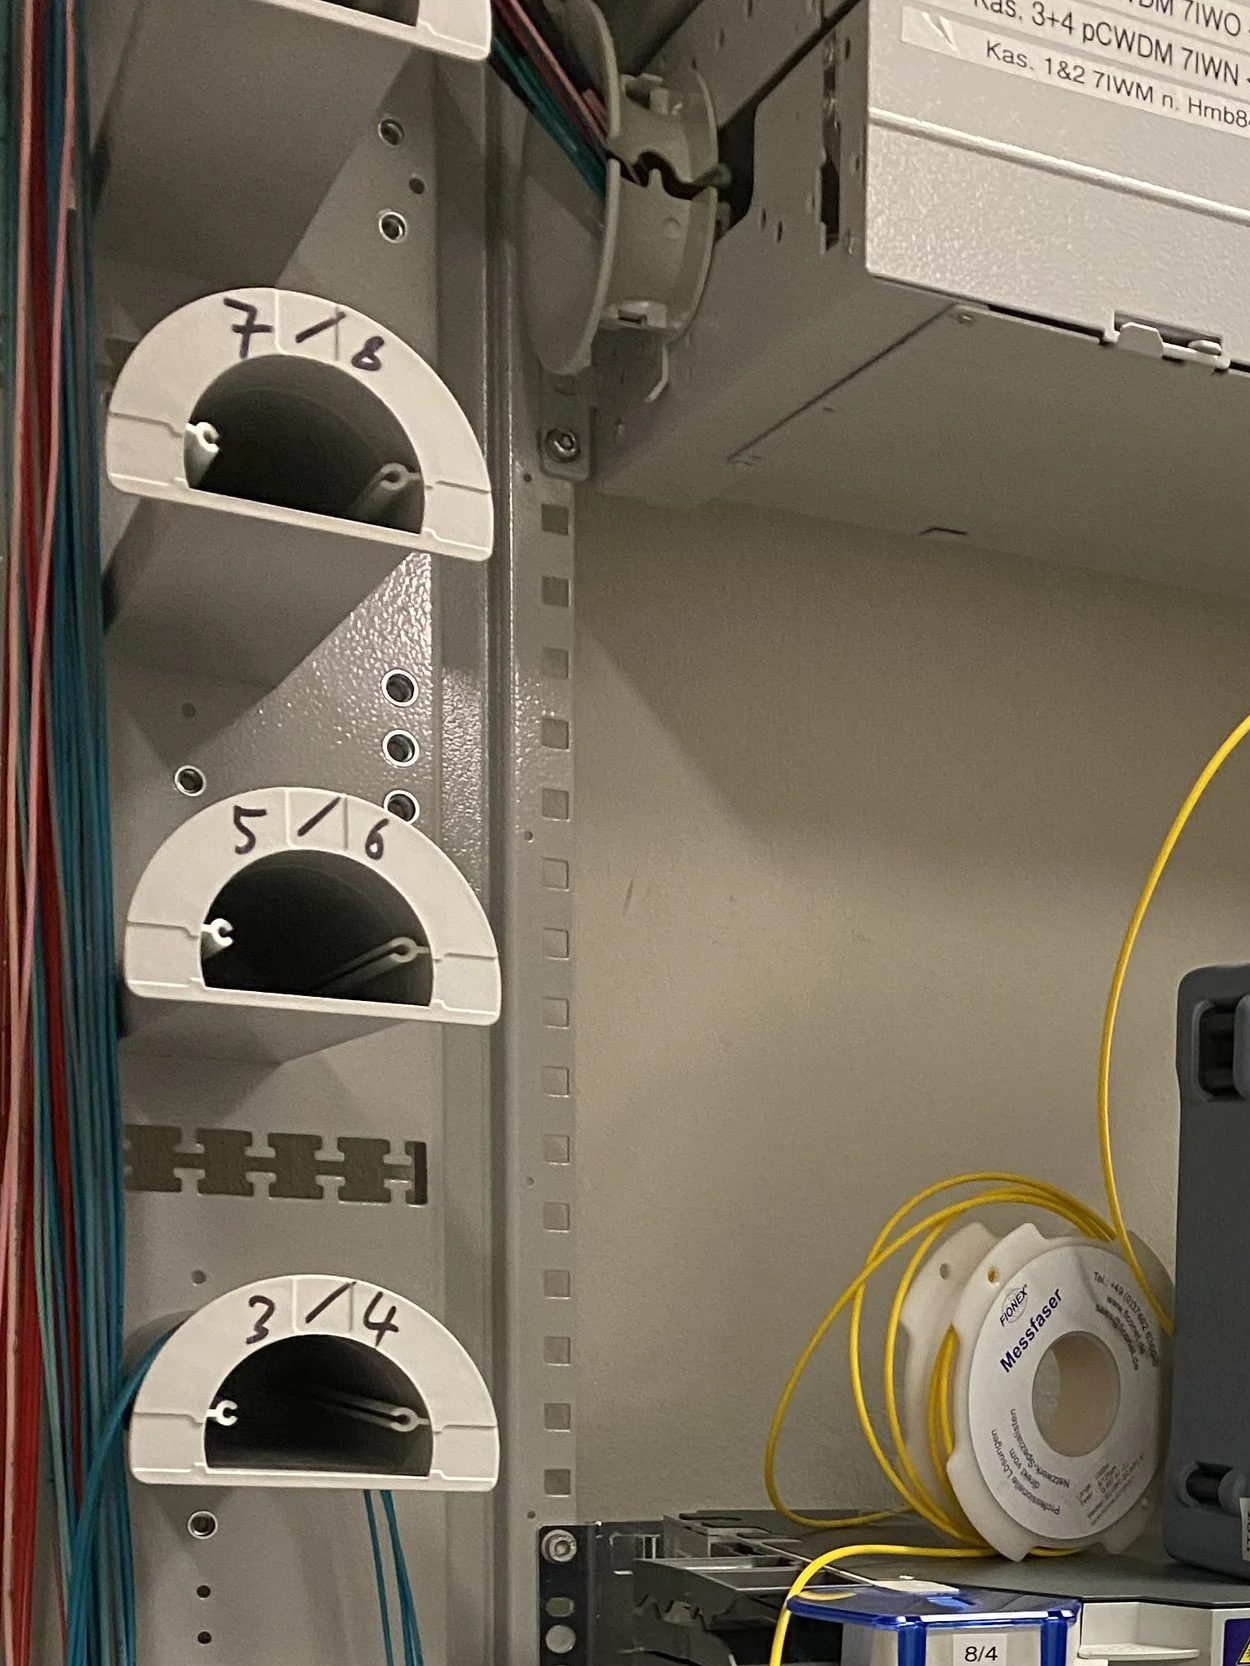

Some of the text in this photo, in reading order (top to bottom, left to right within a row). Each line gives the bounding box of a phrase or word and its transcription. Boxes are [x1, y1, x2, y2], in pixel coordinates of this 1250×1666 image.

[986, 40, 1034, 70] Kas.
[1045, 58, 1085, 84] 1&2
[1093, 71, 1154, 103] 7IWM
[1032, 5, 1074, 35] 3+4
[1082, 21, 1173, 66] pCWDM
[1182, 47, 1239, 86] 7IWN
[1000, 1285, 1027, 1327] FIONEX
[1000, 1289, 1062, 1373] Messfaser
[1009, 1448, 1022, 1469] vom
[964, 1645, 998, 1664] 8/4
